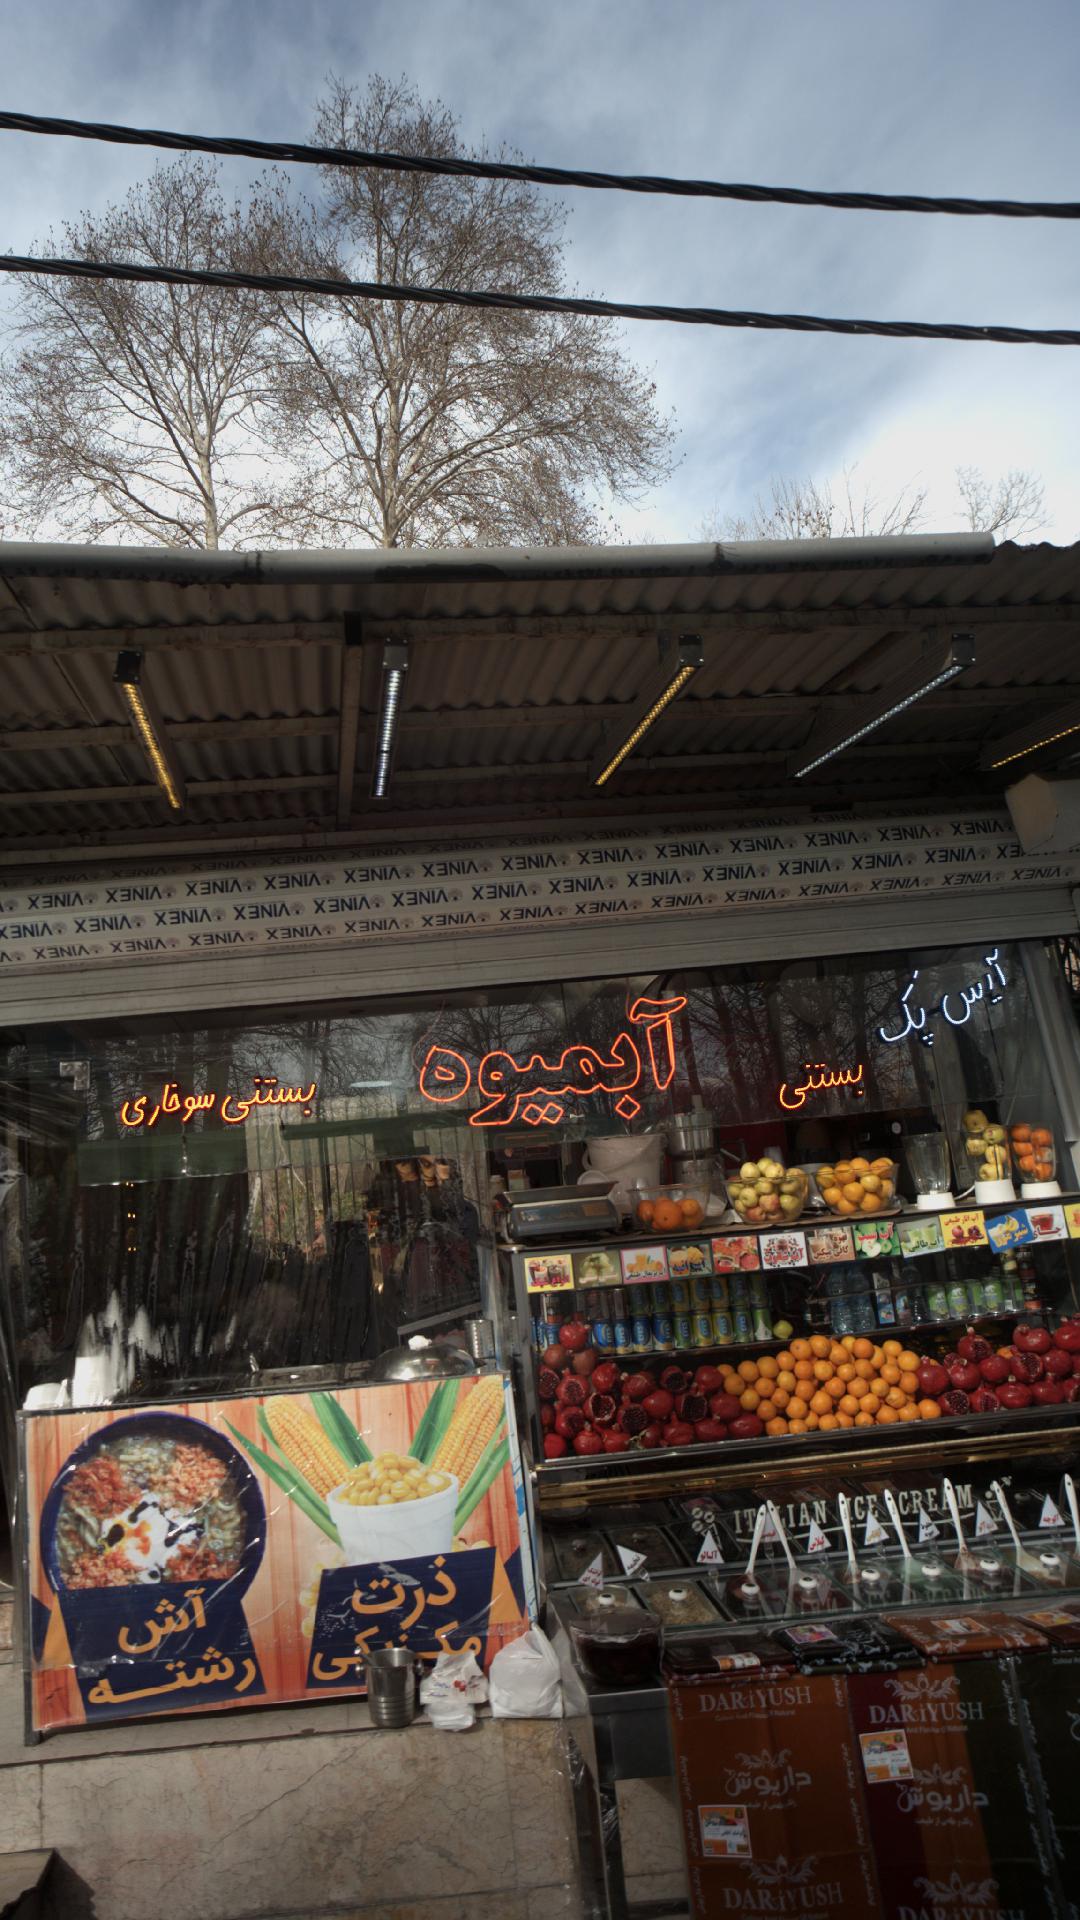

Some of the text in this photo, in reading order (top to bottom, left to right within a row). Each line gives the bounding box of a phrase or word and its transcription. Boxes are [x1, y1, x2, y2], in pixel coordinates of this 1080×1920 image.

[0, 848, 976, 940] VINEX VINEX VINEX VINEX VINEX VINEX VINEX VINEX VINEX VINEX VINEX VINEX VINEX
[28, 819, 1003, 910] VINEX VINEX VINEX VINEX VINEX VINEX VINEX VINEX VINEX VINEX VINEX VINEX VINEX
[34, 866, 1061, 960] VINEX VINEX VINEX VINEX VINEX VINEX VINEX VINEX VINEX VINEX VINEX VINEX VINEX VINEX
[880, 970, 935, 1046] پک
[420, 996, 687, 1126] آبمیوه
[780, 1063, 863, 1109] بستنی
[121, 1077, 316, 1126] بستنی سوخاری
[880, 1221, 895, 1240] آب
[733, 1500, 827, 1534] ITIAN
[118, 1587, 207, 1654] آش
[351, 1555, 457, 1631] ذرت
[88, 1646, 257, 1704] رشته
[723, 1764, 813, 1797] داریوش
[896, 1782, 990, 1813] داریوش
